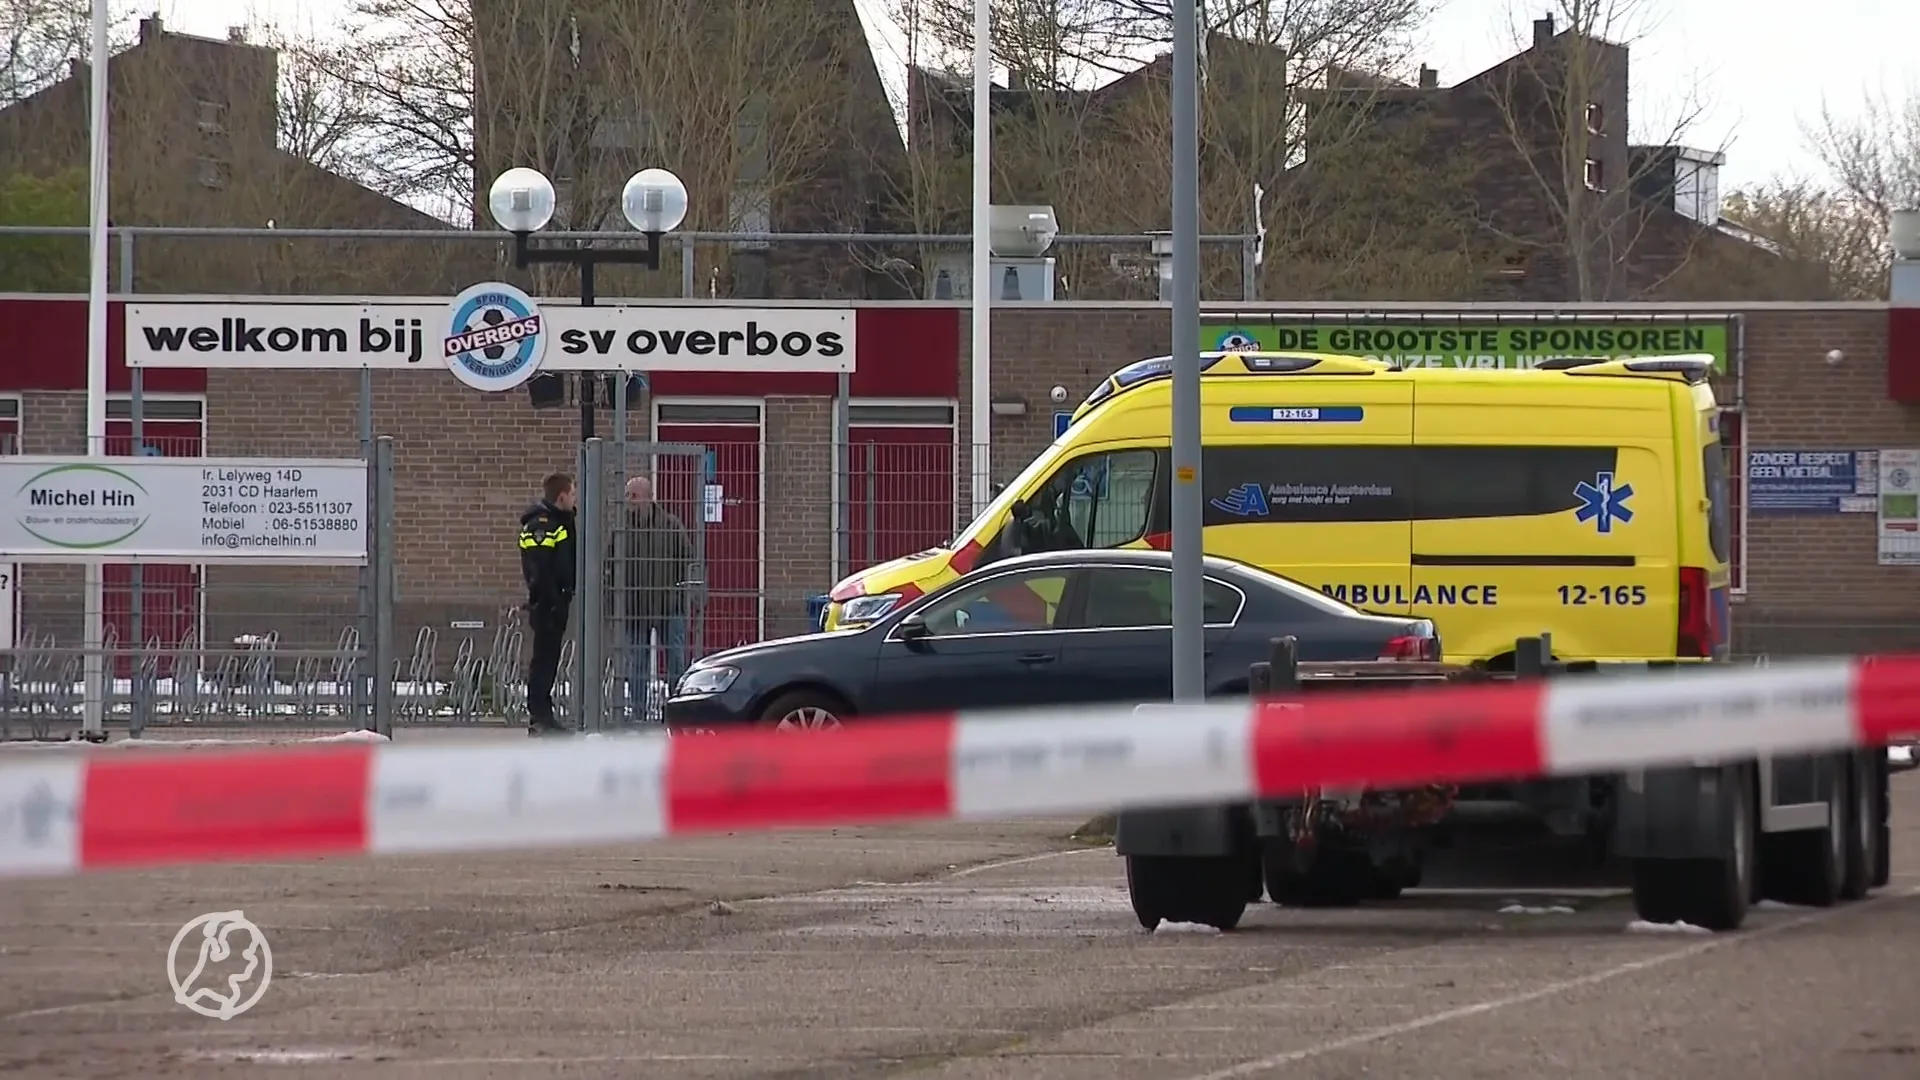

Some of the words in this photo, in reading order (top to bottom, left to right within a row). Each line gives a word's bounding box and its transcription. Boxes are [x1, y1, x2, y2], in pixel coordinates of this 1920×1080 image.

[475, 294, 509, 304] SPORT
[143, 318, 347, 352] welkom
[360, 318, 423, 363] bij
[446, 319, 538, 354] OVERBOS
[560, 329, 616, 354] sv
[627, 322, 844, 356] overbos
[1279, 329, 1319, 350] DE
[1330, 329, 1498, 351] GROOTSTE
[1509, 329, 1705, 351] SPONSOREN
[464, 357, 523, 377] VERENIGING
[1279, 410, 1313, 418] 12-165
[1751, 453, 1797, 465] ZONDER
[1798, 453, 1849, 465] RESPECT
[202, 469, 214, 481] Ir.
[218, 469, 272, 484] Lelyweg
[277, 469, 302, 481] 14D
[1751, 466, 1781, 478] GEEN
[202, 485, 233, 497] 2031
[238, 485, 260, 497] CD
[264, 485, 318, 498] Haarlem
[1268, 483, 1329, 496] Ambulance
[1330, 483, 1392, 496] Amsterdam
[31, 489, 95, 506] Michel
[102, 489, 135, 506] Hin
[203, 501, 257, 514] Telefoon
[268, 502, 352, 514] 023-5511307
[202, 517, 245, 530] Mobiel
[272, 518, 358, 531] 06-51538880
[202, 534, 317, 549] info@michelhin.nl
[1322, 584, 1498, 605] MBULANCE
[1557, 585, 1647, 605] 12-165
